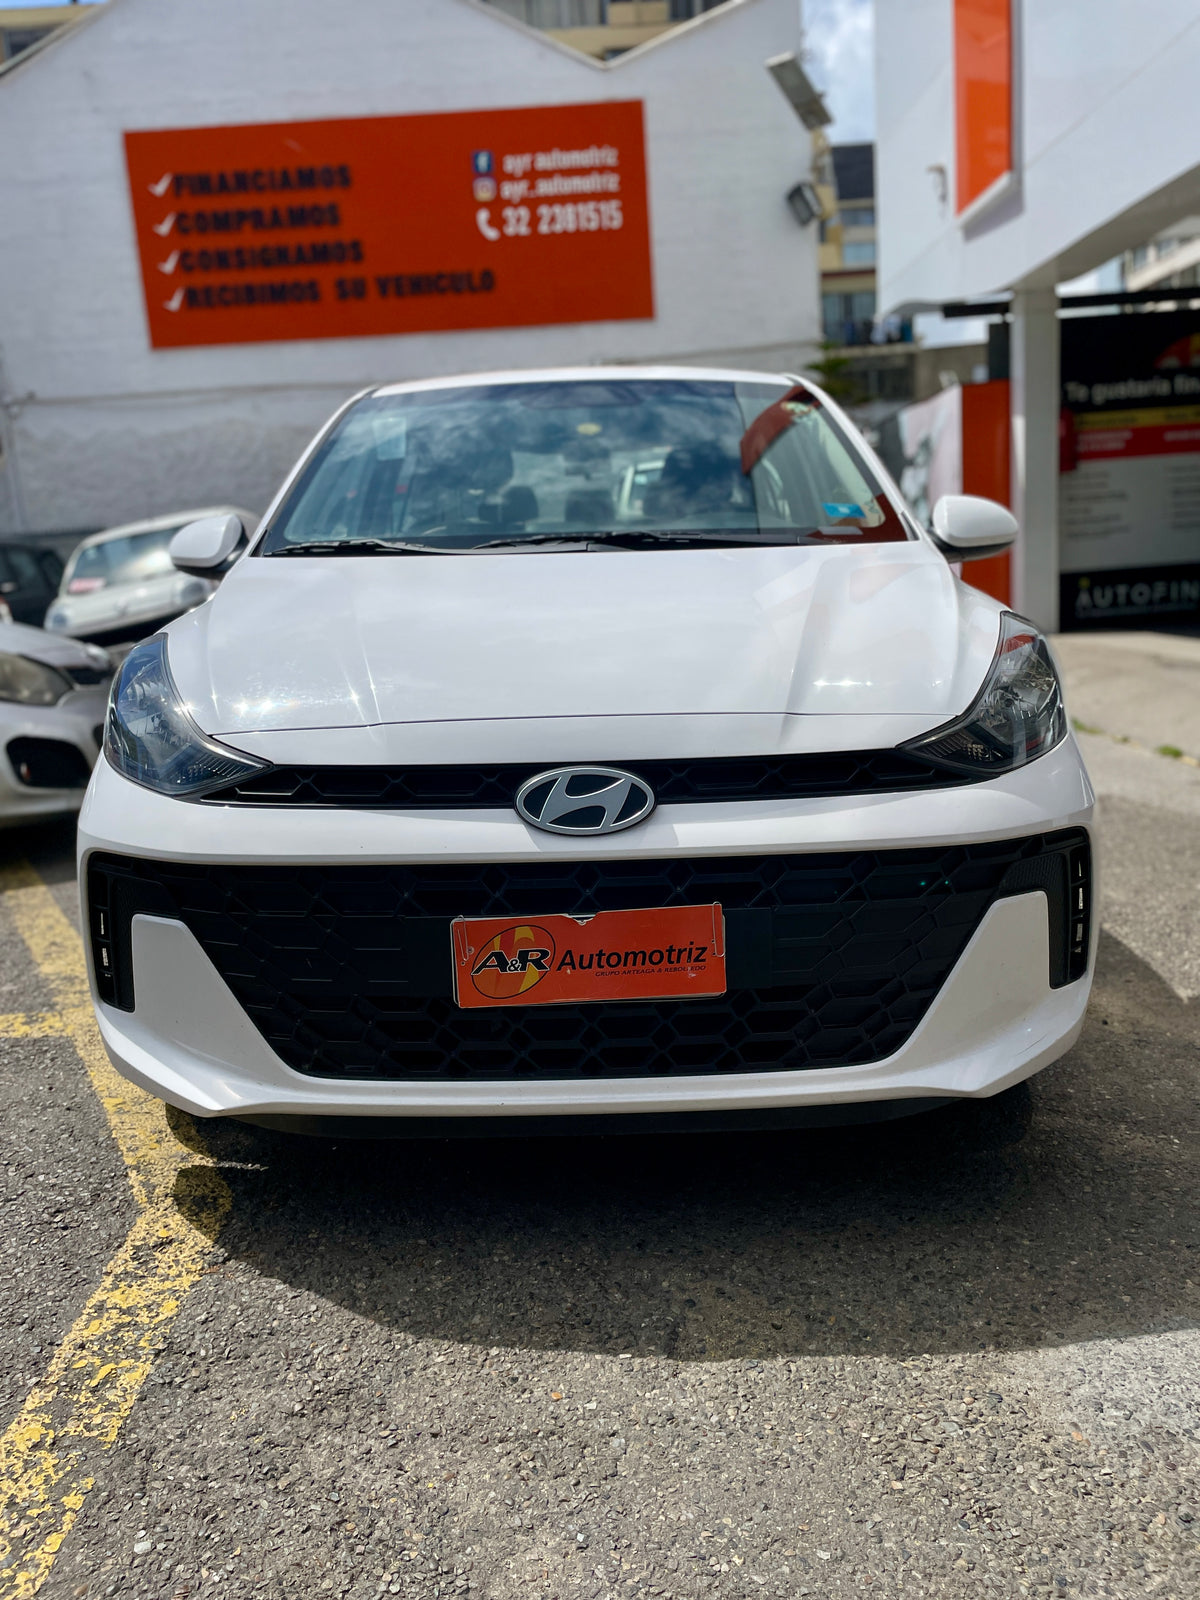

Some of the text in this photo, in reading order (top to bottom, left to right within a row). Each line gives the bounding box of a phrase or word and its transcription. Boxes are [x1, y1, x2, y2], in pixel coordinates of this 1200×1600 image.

[502, 145, 619, 178] ayr automotriz
[173, 165, 352, 196] FINANCIAMOS
[176, 203, 340, 235] COMPRAMOS
[502, 206, 532, 236] 32
[180, 241, 363, 273] CONSIGNAMOS
[186, 268, 495, 309] RECIBIMOS SU VEHICULO
[471, 941, 708, 976] A&R Automotriz
